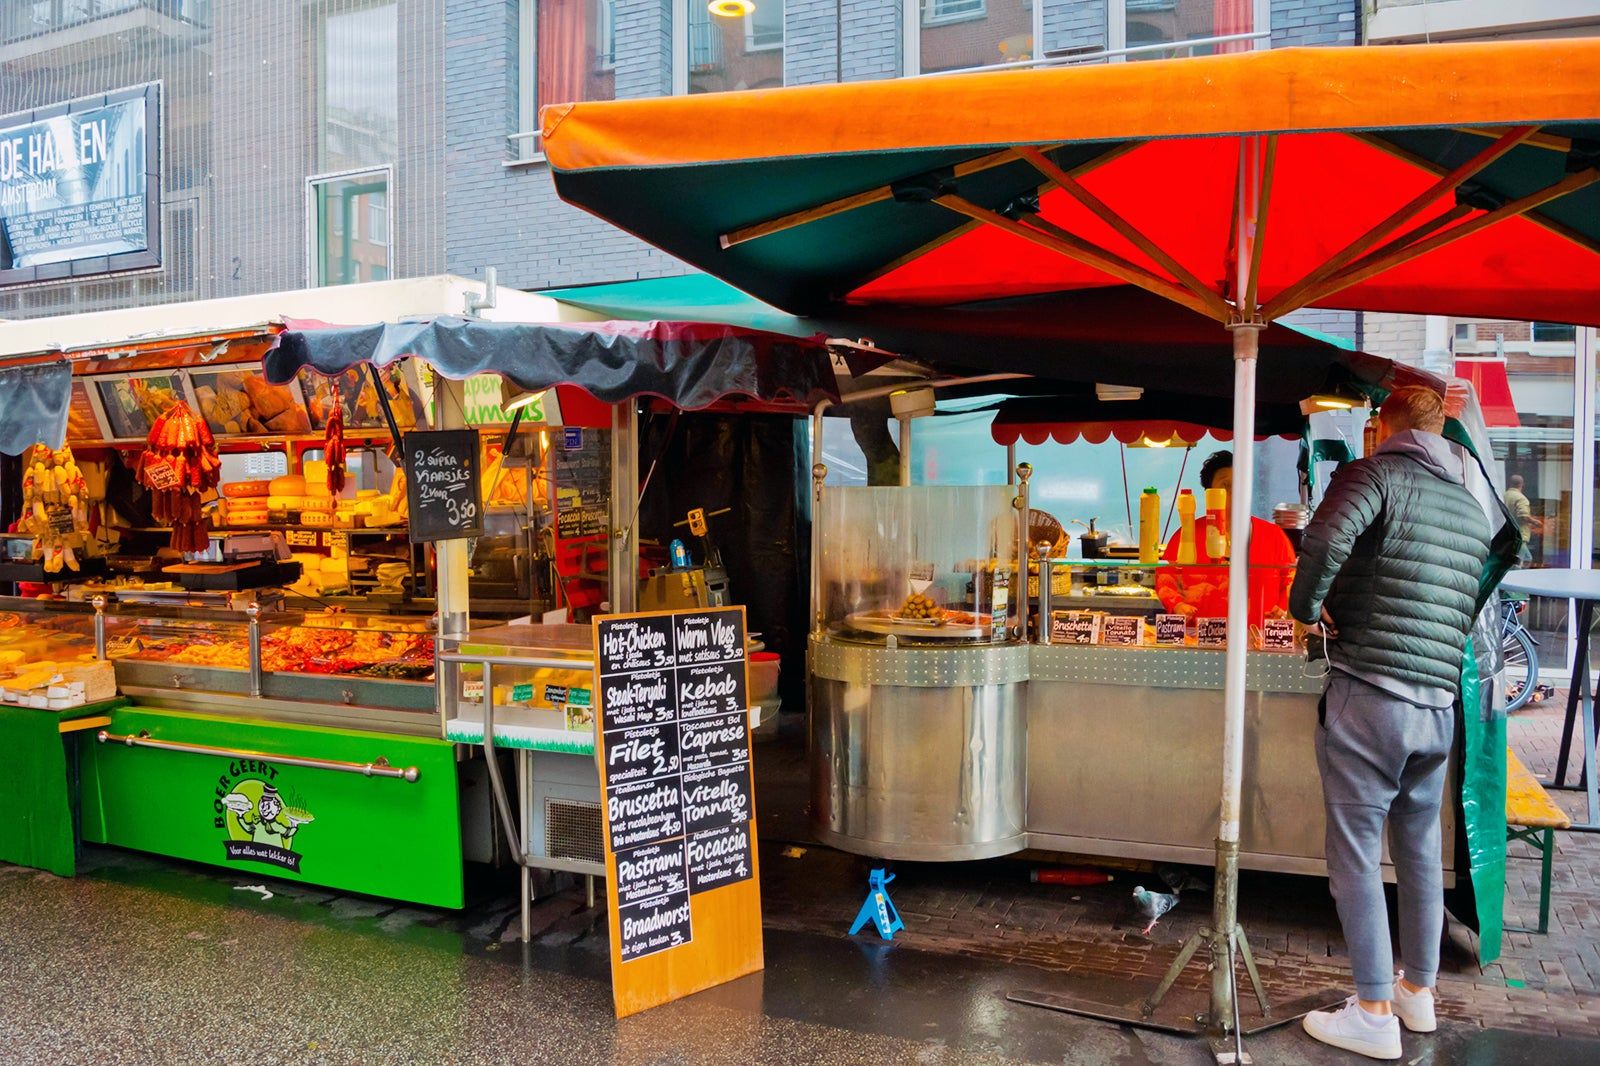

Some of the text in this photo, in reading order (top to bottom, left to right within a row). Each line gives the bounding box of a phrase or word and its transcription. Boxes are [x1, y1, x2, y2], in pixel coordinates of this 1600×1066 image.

[0, 119, 106, 181] DE HALEN
[415, 450, 425, 467] 2
[420, 484, 430, 498] 2
[611, 622, 638, 630] Pistoletje
[684, 617, 709, 625] Pistoletje
[1054, 620, 1092, 631] Bruschetta
[604, 626, 666, 655] Hot-Chicken
[677, 618, 735, 651] Warm Vlees
[654, 650, 674, 667] 3,50
[679, 651, 693, 663] met
[724, 644, 743, 659] 3,50
[631, 671, 661, 680] Pistoletje
[690, 666, 724, 675] Pistoletje
[681, 673, 737, 702] Kebab
[637, 712, 653, 722] Mayo
[680, 719, 724, 731] Toscaanse
[624, 727, 660, 739] Pistoletje
[681, 725, 744, 752] Caprese
[609, 738, 665, 766] Filet
[652, 755, 679, 775] 2,50
[684, 765, 745, 783] Biologische Baguette
[214, 760, 279, 828] BOER GEERT
[683, 779, 739, 804] Vitello
[608, 785, 679, 821] Bruscetta
[682, 794, 746, 823] Tonnato
[611, 821, 626, 833] met
[660, 818, 681, 836] 4,50
[633, 846, 660, 858] Pistoletje
[687, 827, 747, 865] Focaccia
[230, 845, 241, 855] Voor
[243, 846, 256, 856] alles
[268, 849, 286, 863] lekker
[287, 857, 295, 866] is!
[619, 844, 683, 883] Pastrami
[691, 864, 704, 873] met
[618, 884, 631, 893] met
[640, 896, 669, 909] Pistoletje
[623, 901, 689, 940] Braadworst
[631, 941, 647, 954] eigen
[648, 935, 669, 947] keuken
